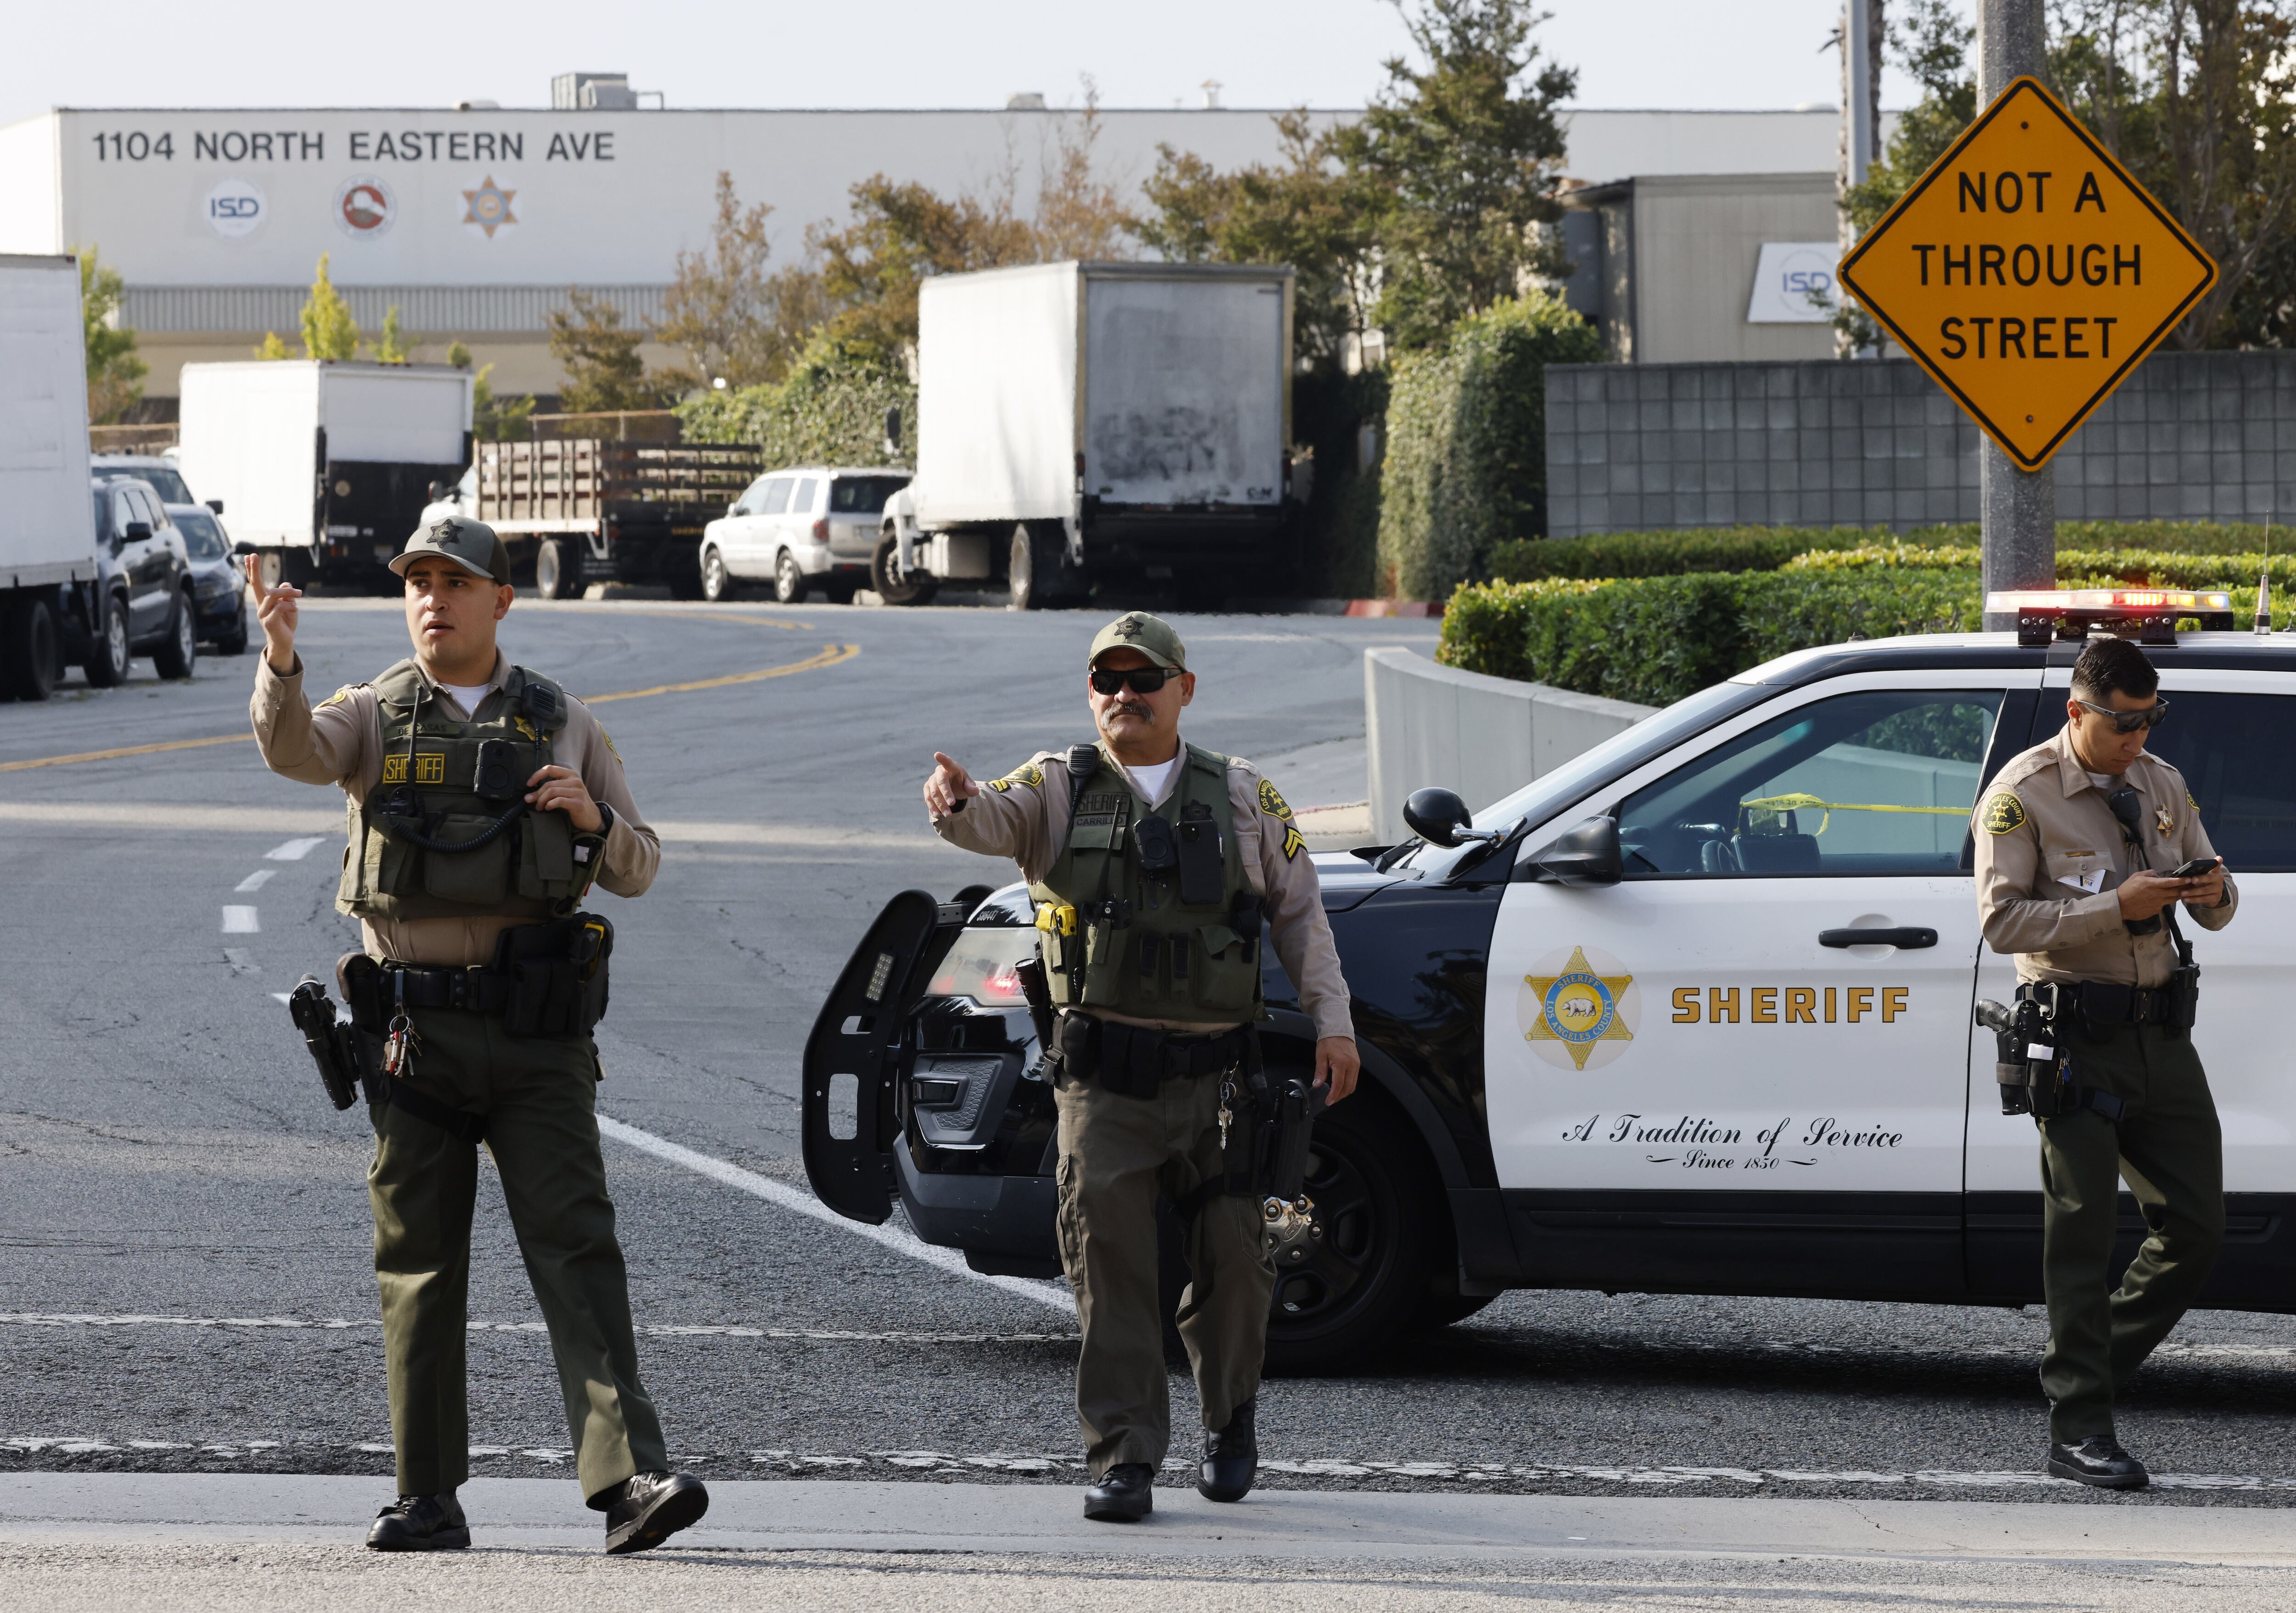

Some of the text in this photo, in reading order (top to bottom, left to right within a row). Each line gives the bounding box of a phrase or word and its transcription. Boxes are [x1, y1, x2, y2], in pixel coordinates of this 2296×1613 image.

[93, 131, 614, 160] 1104 NORTH EASTERN AVE
[1958, 171, 2107, 213] NOT A
[211, 197, 259, 218] ISD
[1912, 243, 2142, 286] THROUGH
[1782, 272, 1831, 293] ISD
[1940, 316, 2118, 359] STREET
[1261, 798, 1270, 809] LOS
[1989, 795, 2010, 807] ANGELES
[2009, 799, 2022, 821] COUNTY
[1557, 975, 1600, 988] SHERIFF
[1671, 987, 1908, 1023] SHERIFF
[1546, 999, 1611, 1041] LOS ANGELES COUNTY
[1562, 1114, 1902, 1156] A Tradition of Service
[1683, 1150, 1779, 1169] Since 1850
